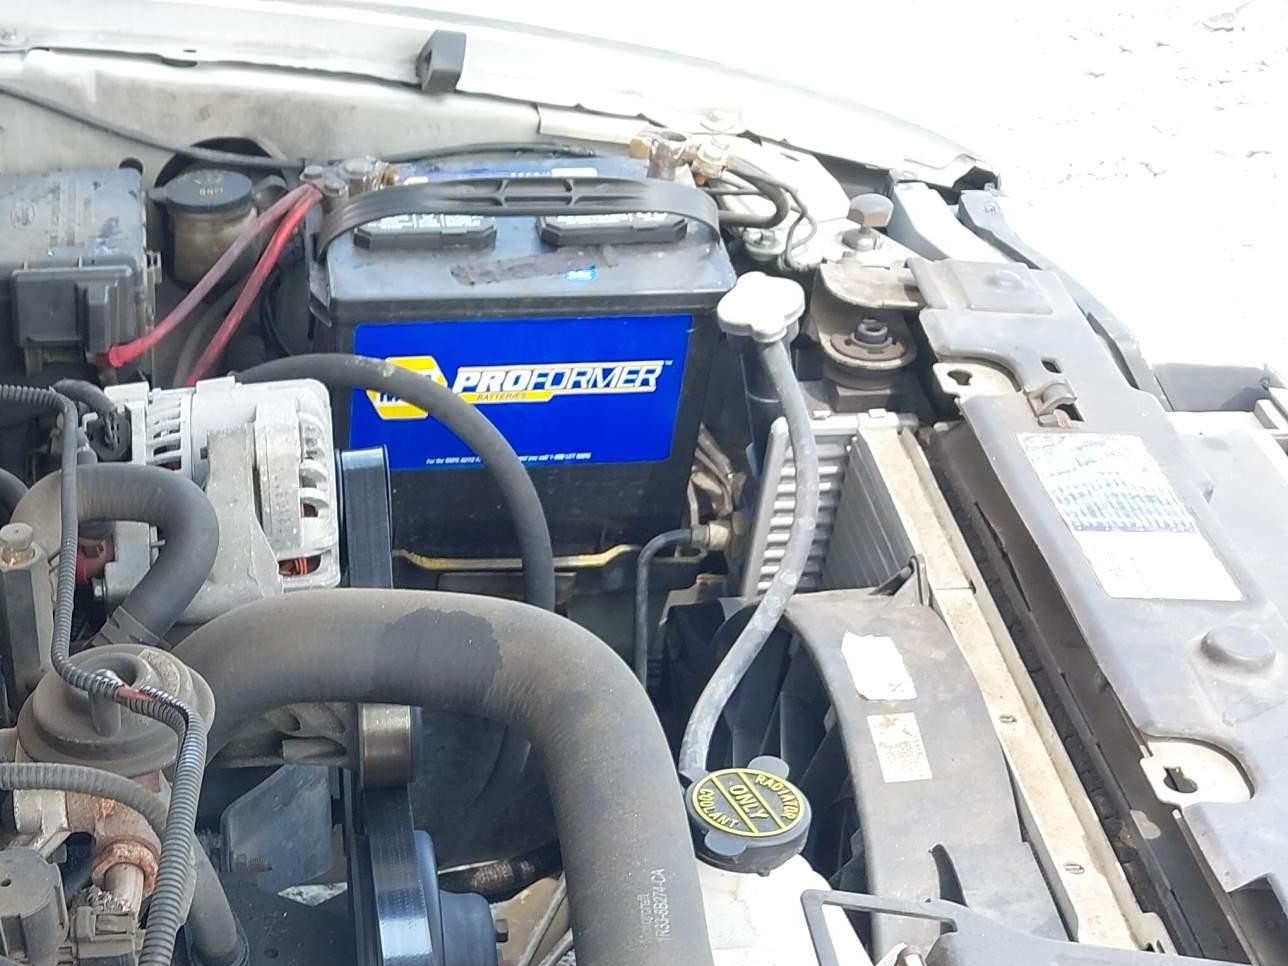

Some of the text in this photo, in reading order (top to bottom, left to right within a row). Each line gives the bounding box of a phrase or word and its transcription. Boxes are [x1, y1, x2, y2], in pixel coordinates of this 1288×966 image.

[452, 366, 662, 393] PROFORMER
[697, 788, 740, 828] COOLANT
[729, 784, 770, 820] ONLY
[754, 773, 799, 821] RADIATOR
